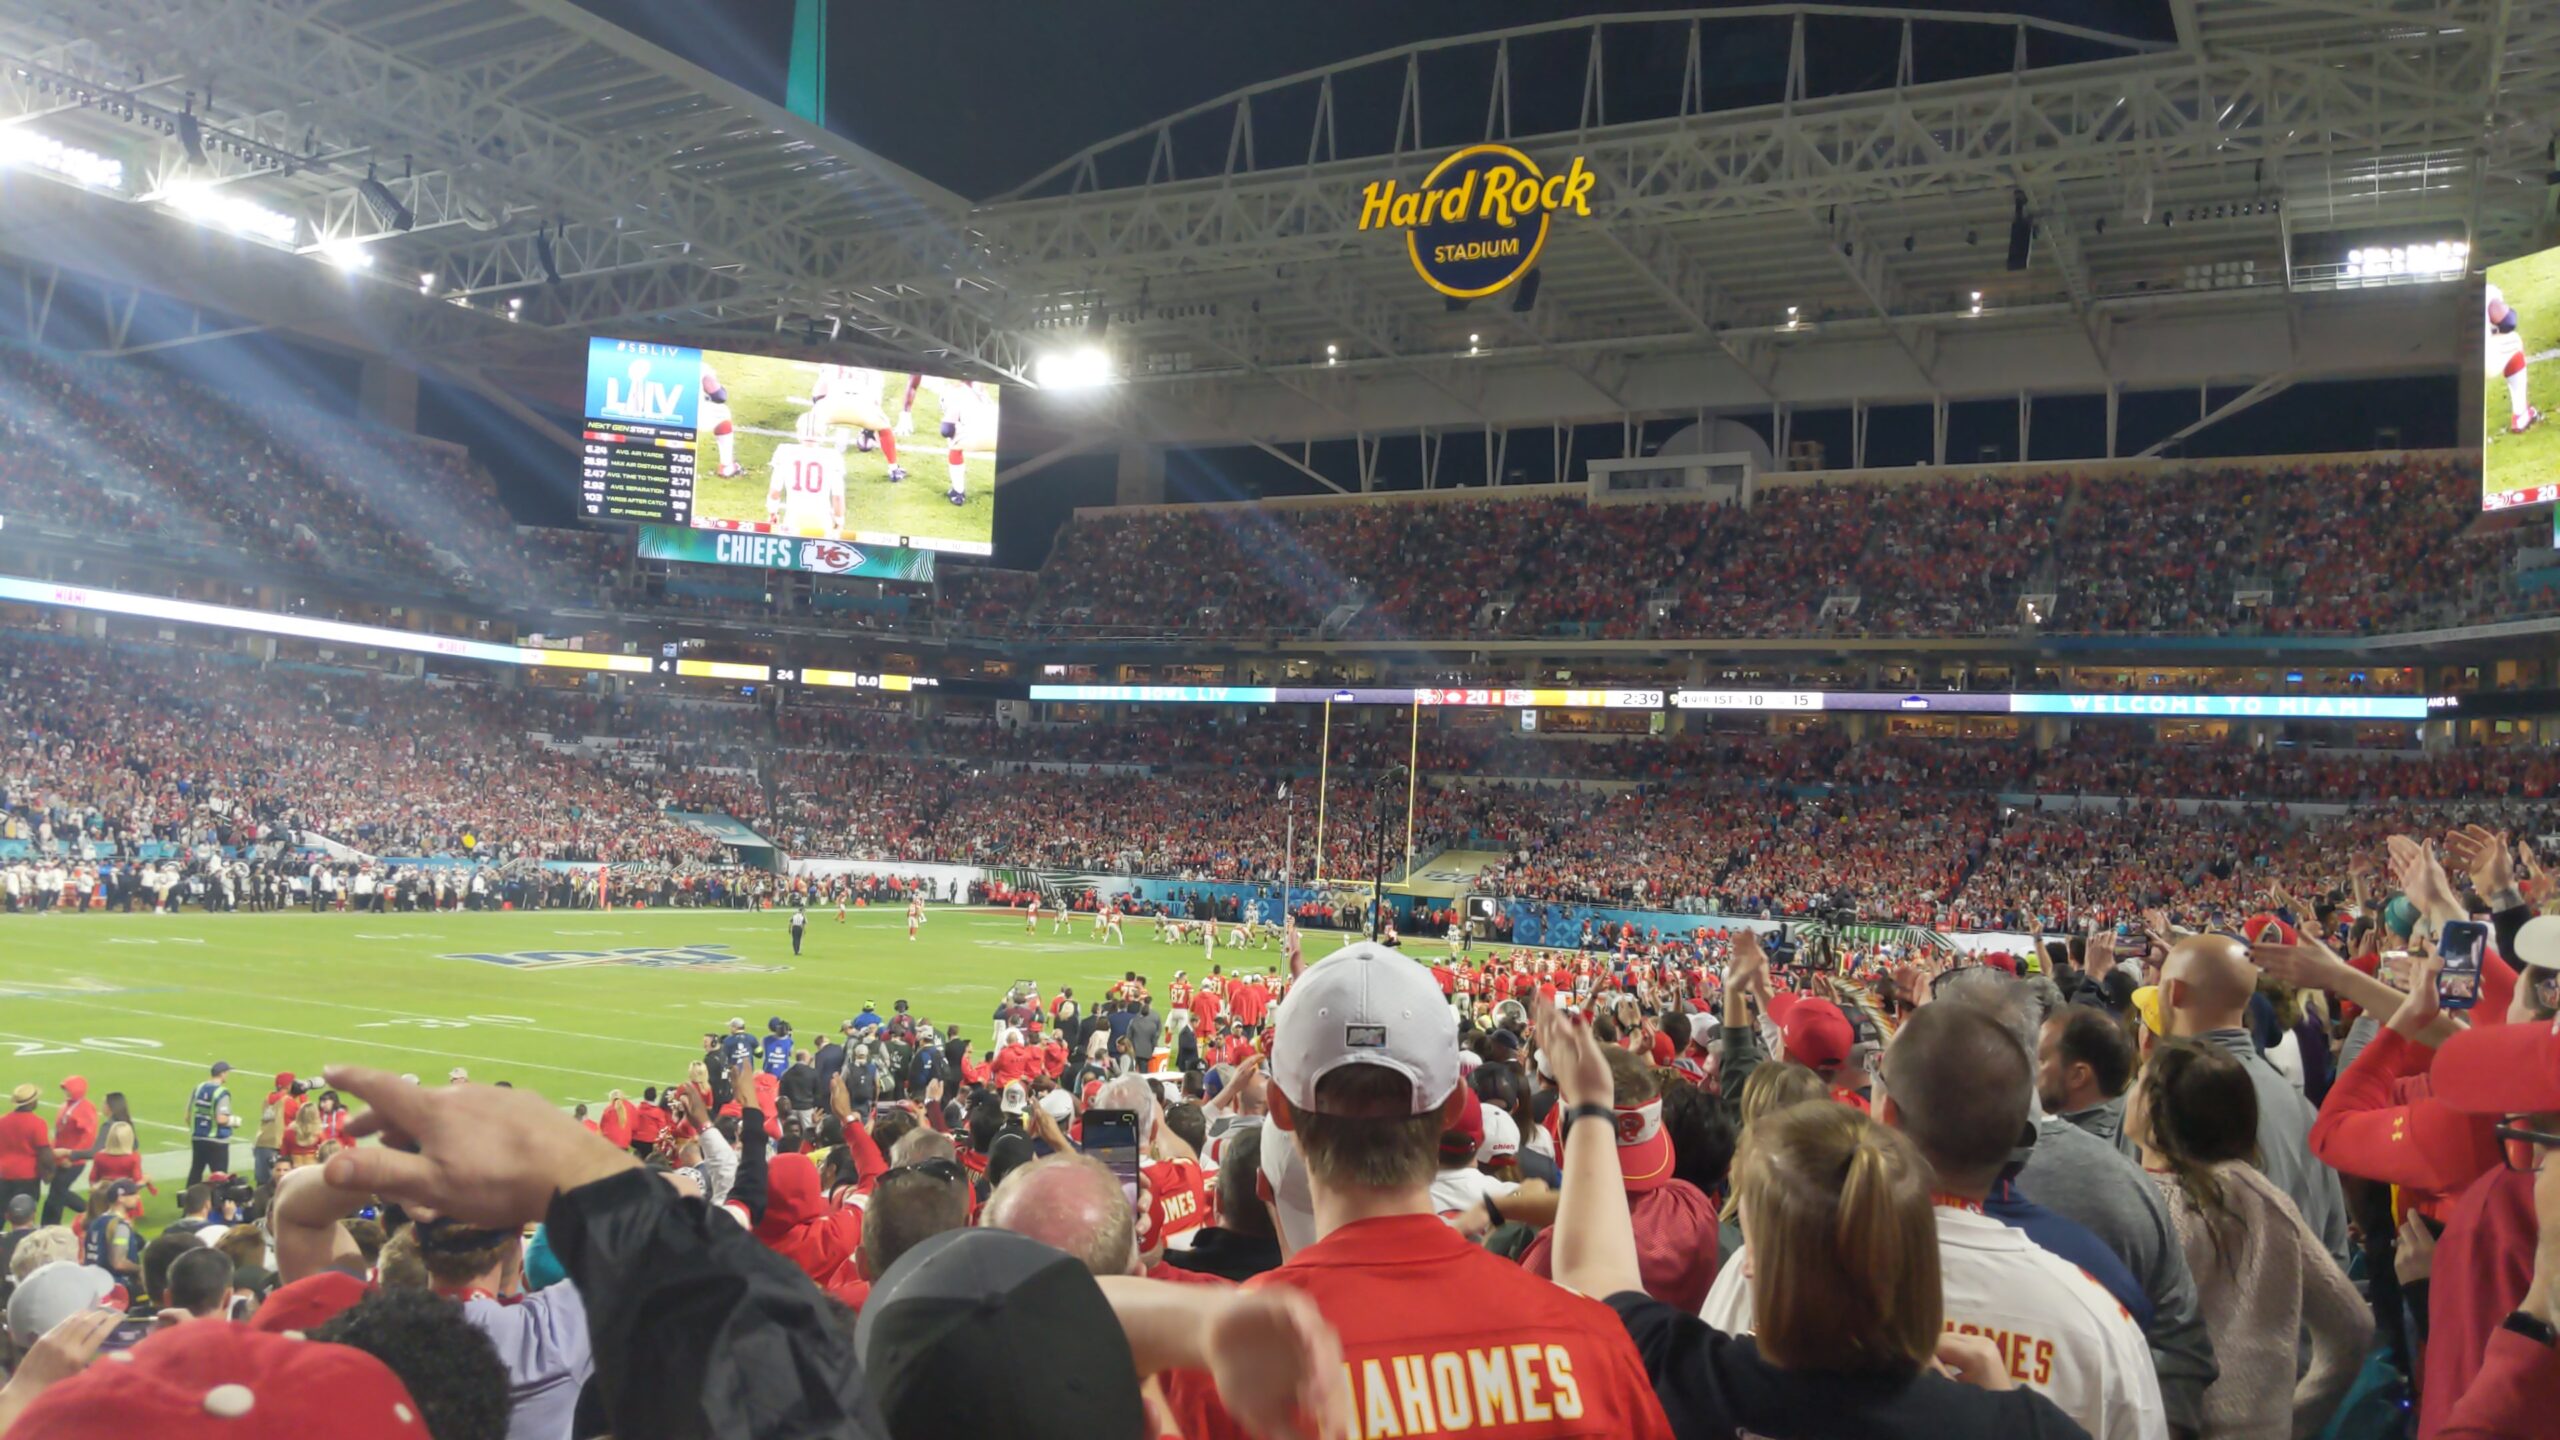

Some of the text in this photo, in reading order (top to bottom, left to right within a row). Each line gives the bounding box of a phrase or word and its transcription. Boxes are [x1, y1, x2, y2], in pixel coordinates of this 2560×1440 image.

[1358, 156, 1596, 231] Hard Rock
[1434, 237, 1520, 264] STADIUM
[588, 421, 611, 430] NEXT
[612, 424, 630, 432] GEN
[629, 426, 656, 435] STATS
[585, 445, 608, 455] 6.24
[637, 462, 667, 471] DISTANCE
[583, 468, 606, 478] 2.47
[671, 477, 691, 486] 2.71
[792, 460, 823, 493] 10
[625, 485, 665, 494] SEPARATION
[2538, 485, 2557, 501] 20
[584, 493, 603, 502] 103
[606, 495, 627, 503] YARDS
[627, 497, 647, 505] AFTER
[624, 508, 662, 517] PRESSURES
[716, 533, 851, 569] CHIEFS KC
[776, 668, 795, 681] 24
[857, 675, 879, 687] 0.0
[1466, 690, 1488, 704] 20
[1623, 693, 1659, 705] 2:39
[1669, 693, 1679, 706] 9
[1713, 695, 1733, 705] 1ST
[1748, 695, 1764, 706] 10
[1793, 695, 1809, 706] 15
[2069, 695, 2373, 716] WELCOME TO MIAMI
[1481, 900, 1494, 917] 9
[1170, 989, 1186, 1004] 87
